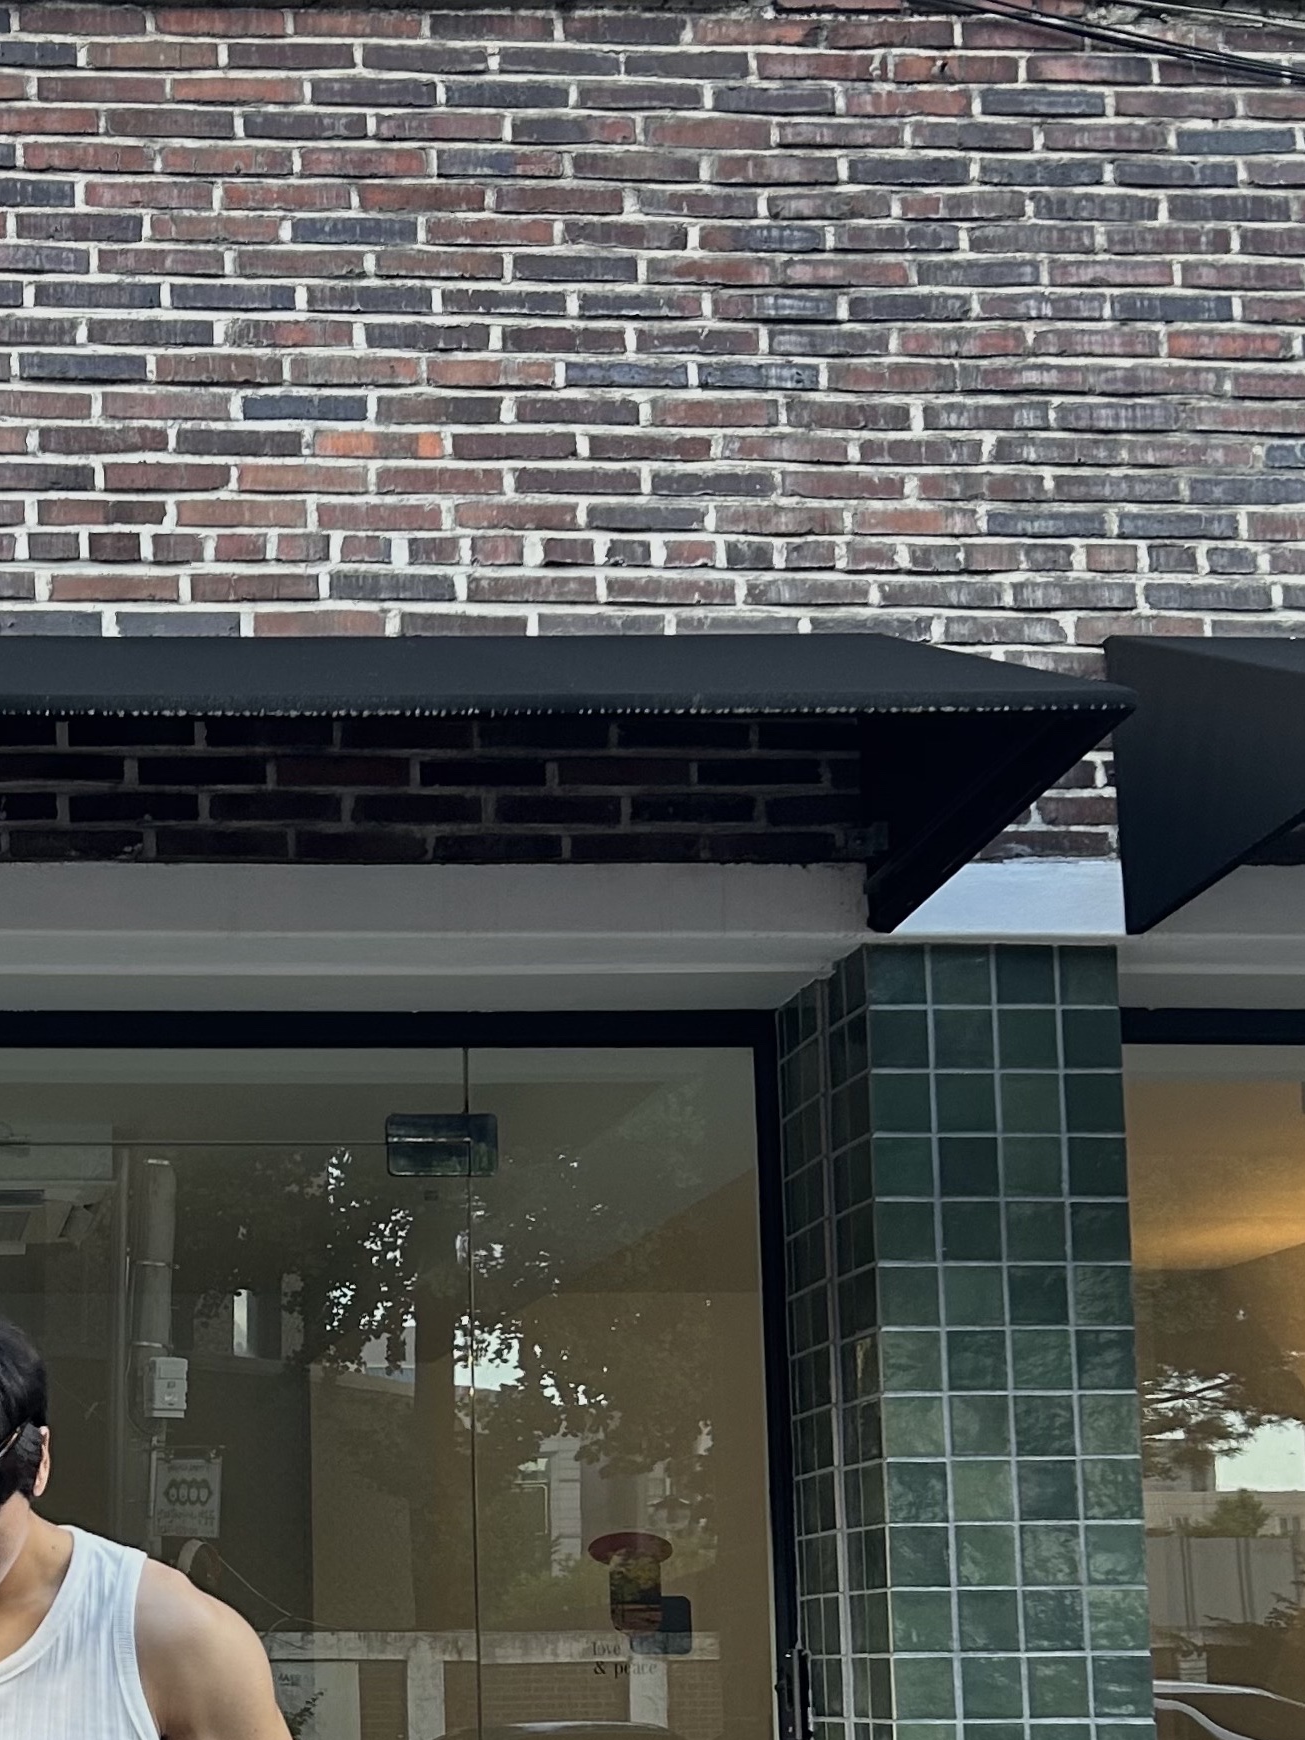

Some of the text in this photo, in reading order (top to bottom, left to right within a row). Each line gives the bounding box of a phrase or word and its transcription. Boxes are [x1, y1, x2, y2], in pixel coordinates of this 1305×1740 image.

[591, 1640, 621, 1656] love
[593, 1661, 658, 1680] & peace
